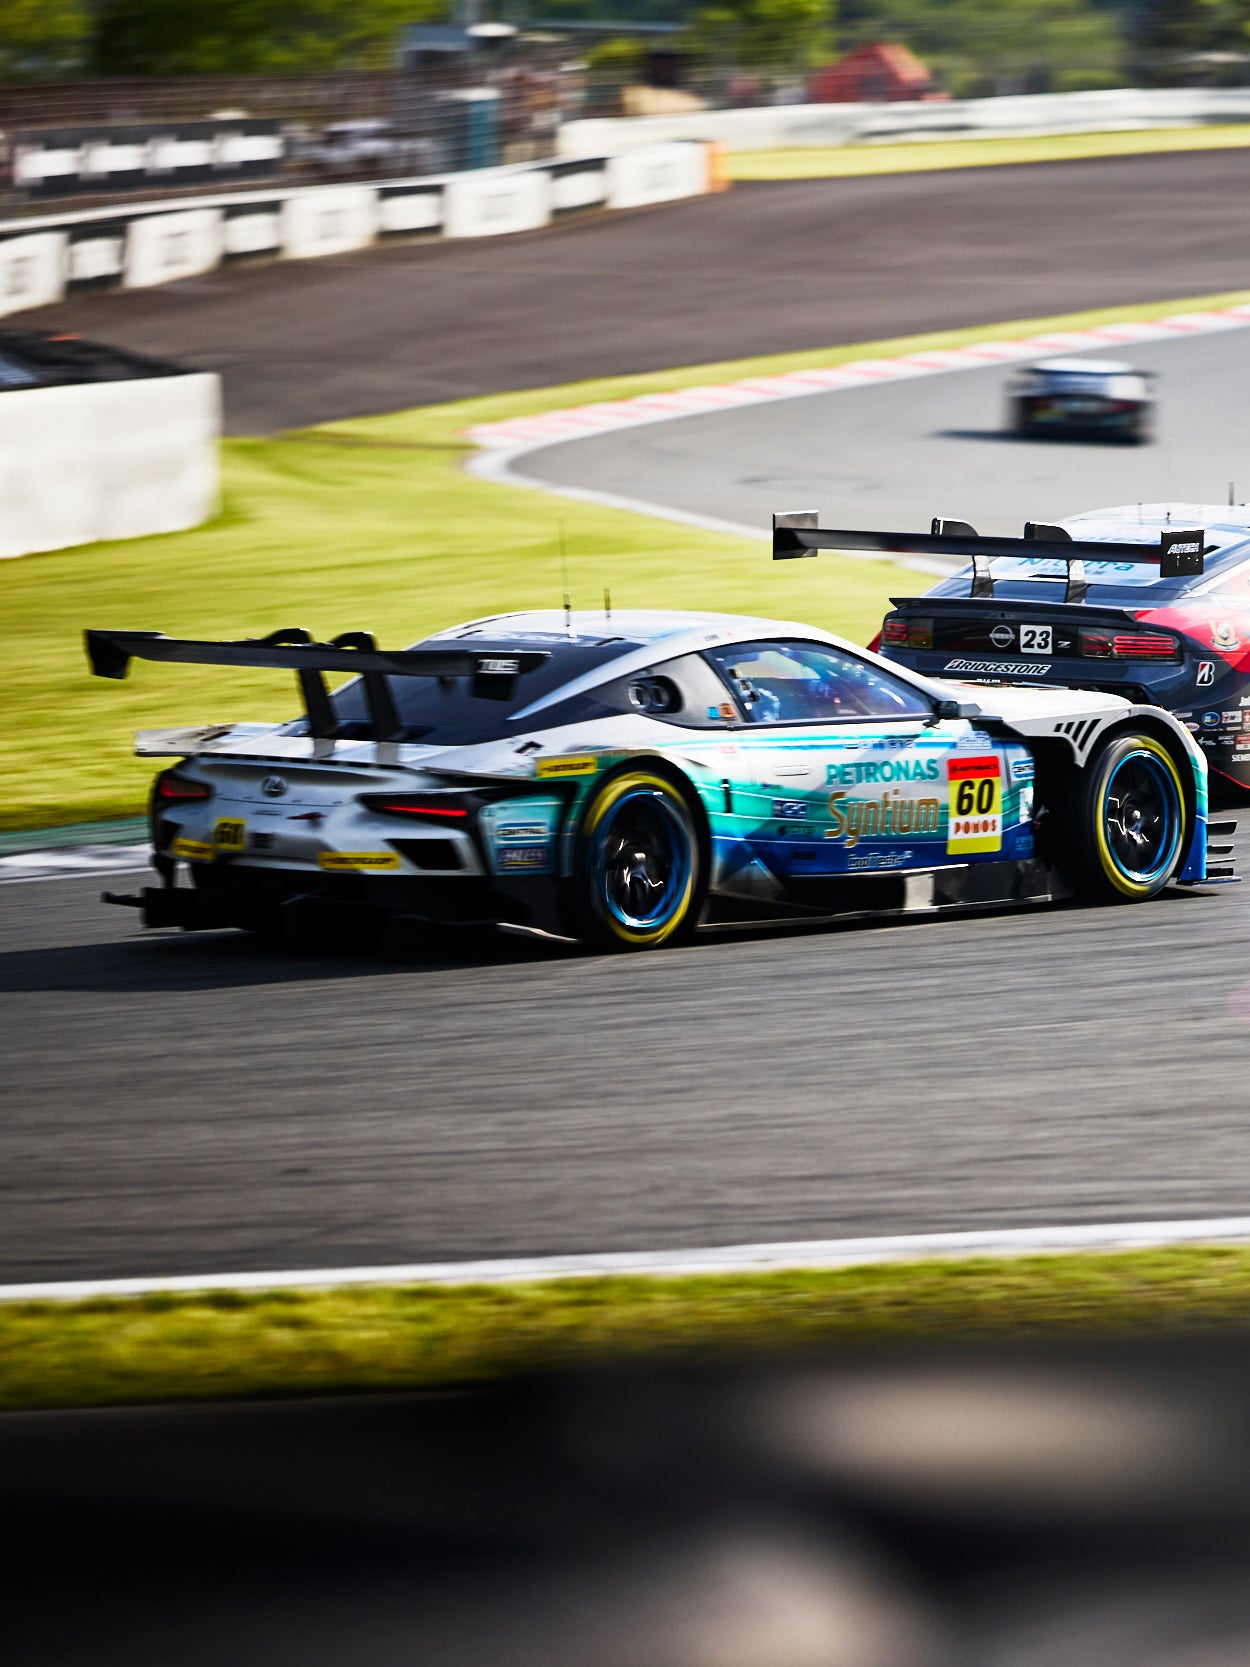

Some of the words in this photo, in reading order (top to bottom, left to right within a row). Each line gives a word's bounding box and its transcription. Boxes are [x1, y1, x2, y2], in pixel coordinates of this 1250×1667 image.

[1166, 542, 1200, 555] AUTECH
[1021, 629, 1051, 650] 23
[943, 659, 1052, 676] BRIDGESTONE
[826, 758, 940, 786] PETRONAS
[956, 778, 994, 815] 60
[824, 788, 940, 849] Syntium
[953, 819, 997, 834] PONOS
